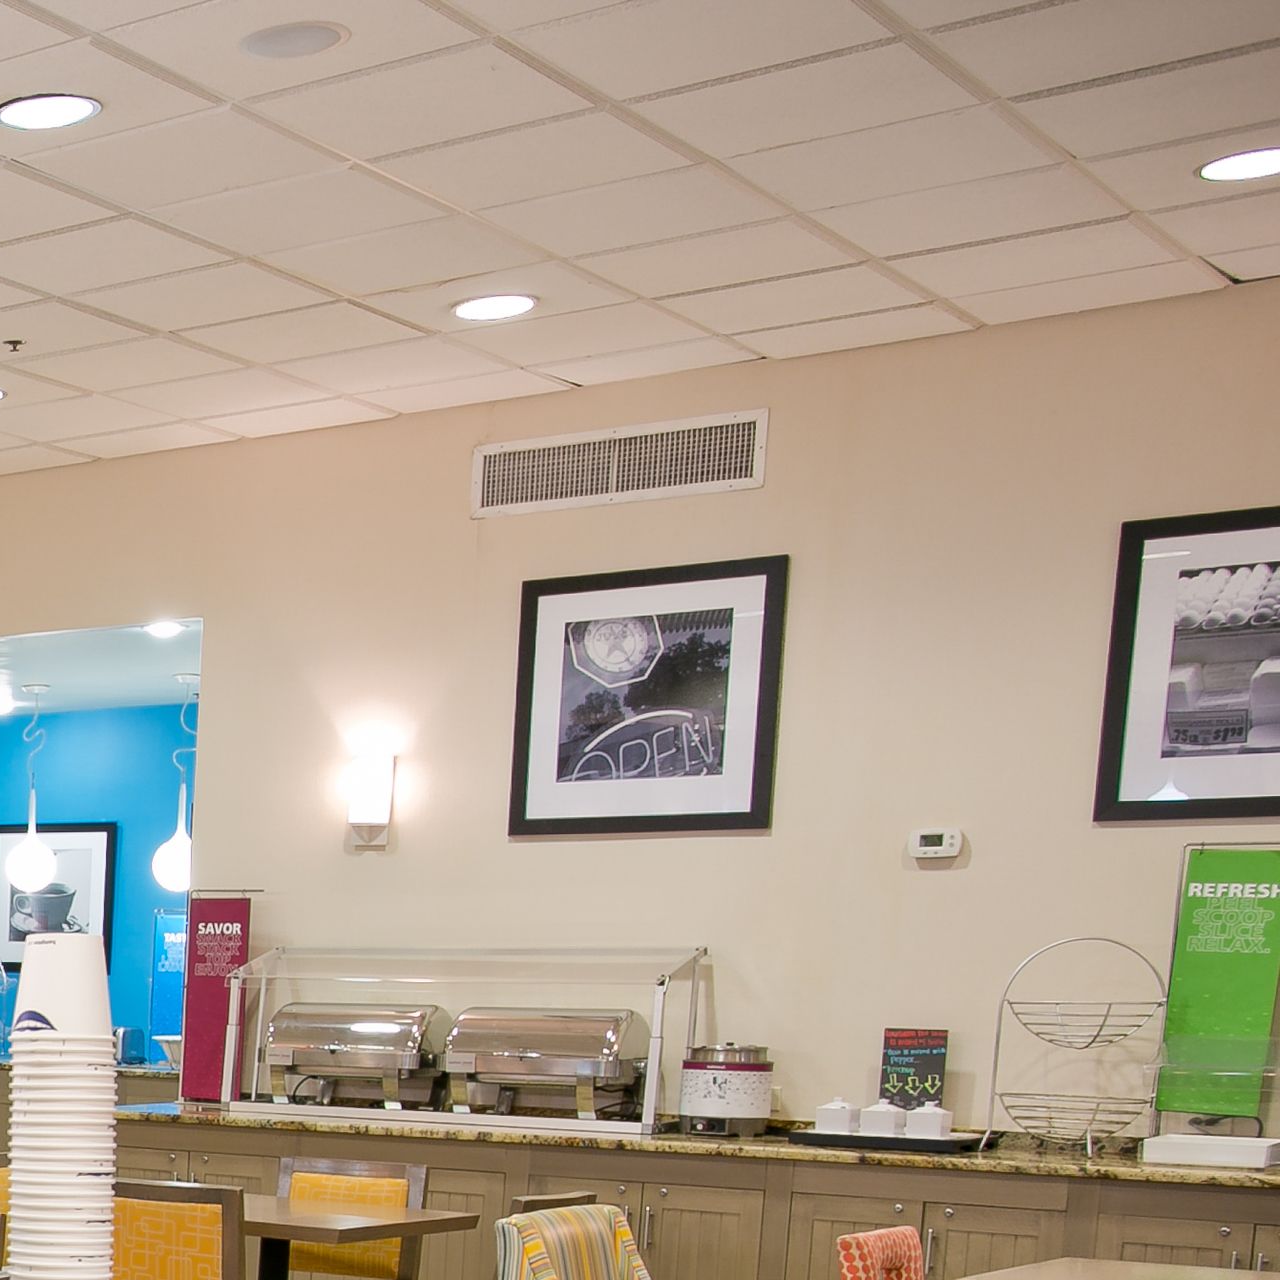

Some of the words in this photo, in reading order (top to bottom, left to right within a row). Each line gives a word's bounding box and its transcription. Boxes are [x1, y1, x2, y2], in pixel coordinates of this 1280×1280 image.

[1187, 882, 1280, 898] REFRESH
[1206, 896, 1263, 910] PEEL
[1192, 908, 1275, 925] SCOOP
[198, 922, 241, 934] SAVOR
[1198, 923, 1265, 939] SLICE
[164, 932, 187, 943] TAST
[1186, 936, 1271, 953] RELAX.
[197, 944, 240, 955] STACK
